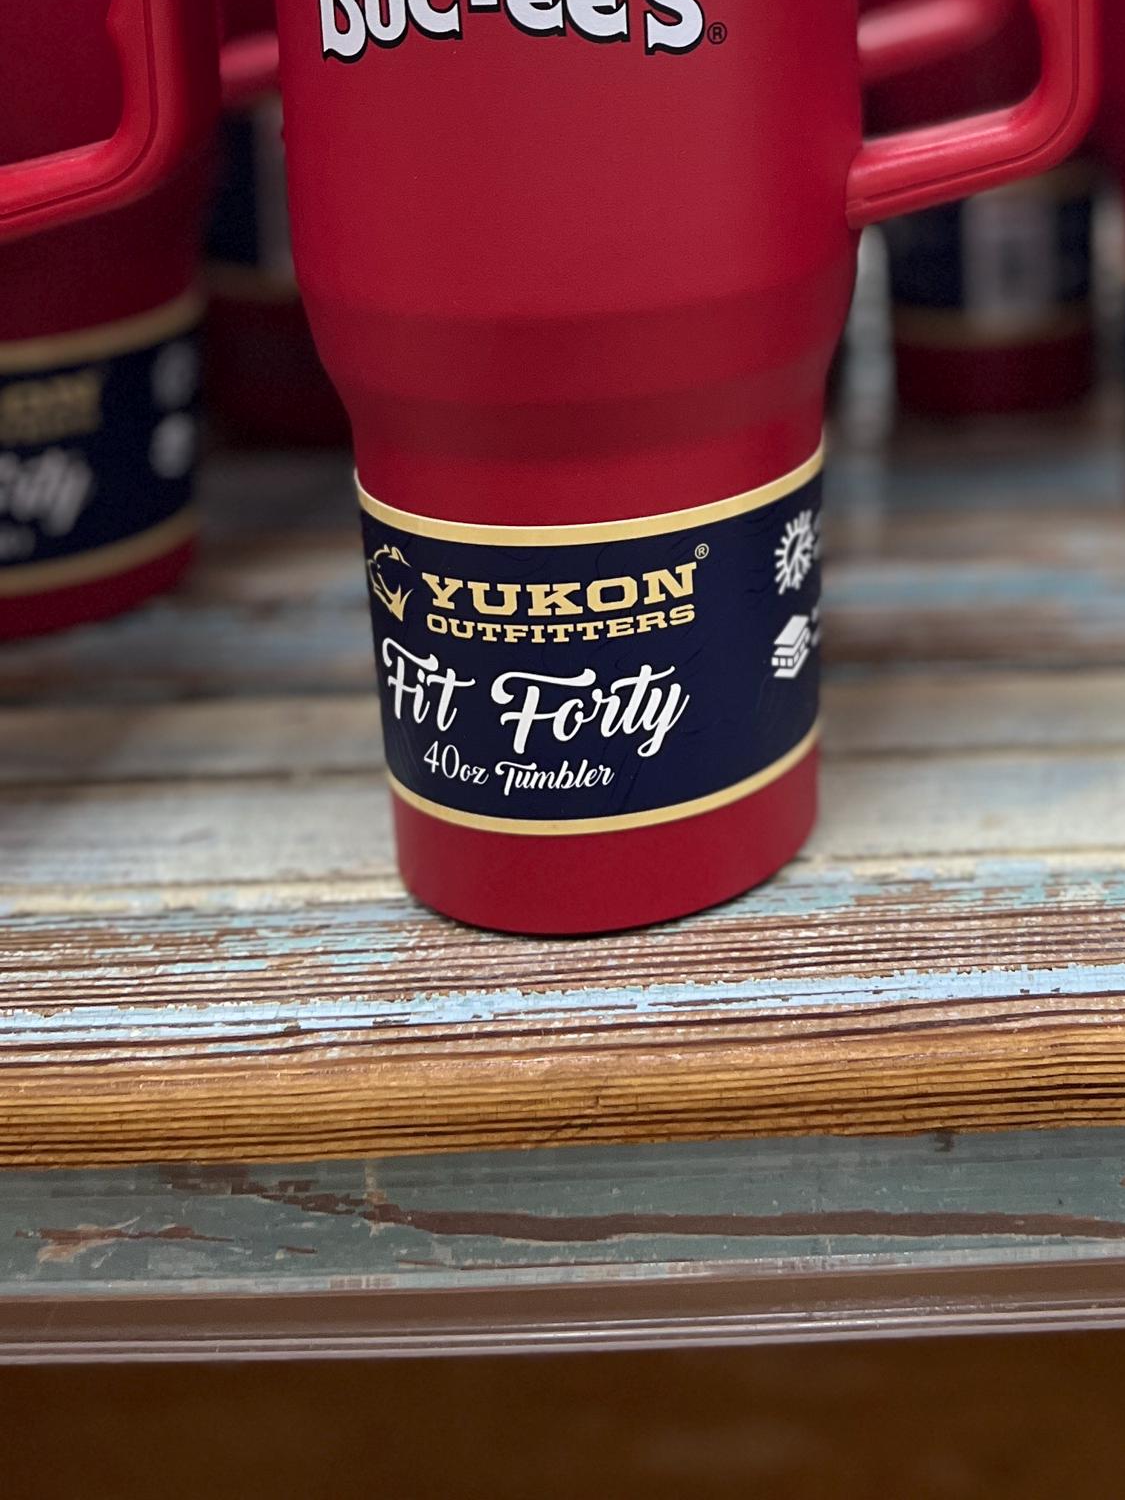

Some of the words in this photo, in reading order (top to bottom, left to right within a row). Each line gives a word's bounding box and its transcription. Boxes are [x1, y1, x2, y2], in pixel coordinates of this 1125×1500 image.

[421, 561, 697, 617] YUKON
[426, 603, 696, 643] OUTFITTERS
[382, 637, 476, 732] Fit
[490, 664, 690, 757] Forty
[423, 740, 489, 785] 40oz
[494, 758, 615, 796] Tumbler
